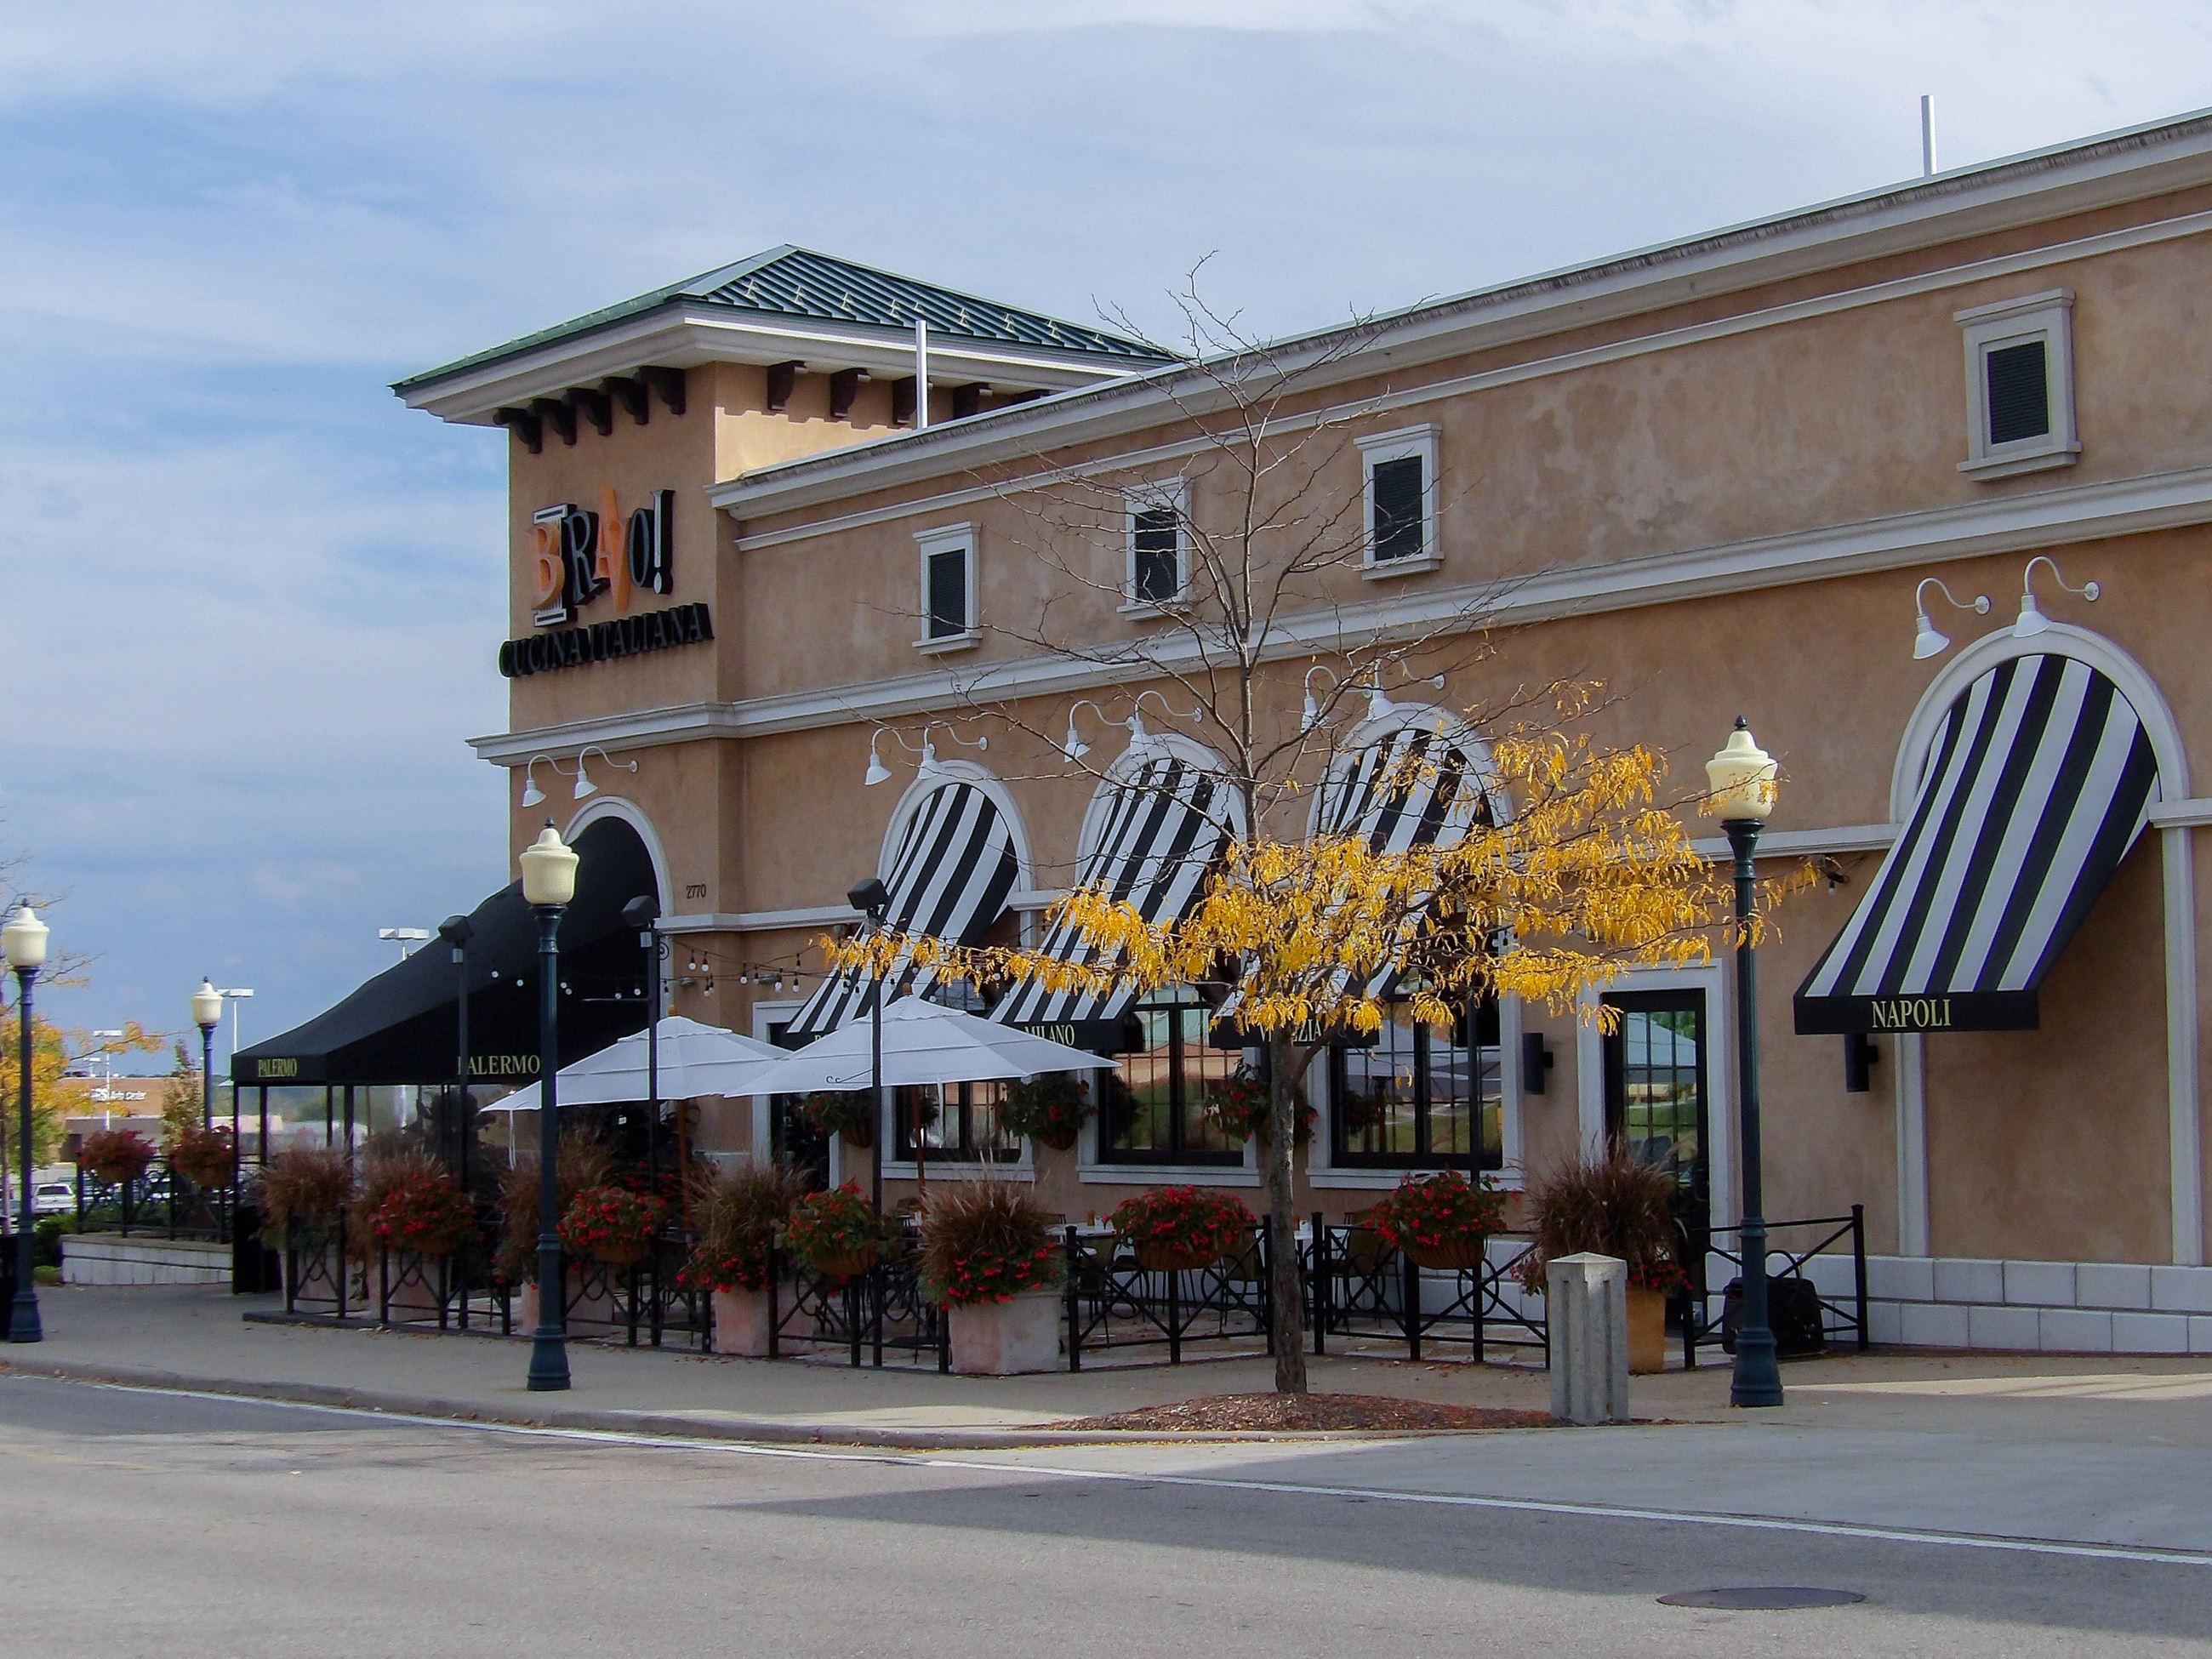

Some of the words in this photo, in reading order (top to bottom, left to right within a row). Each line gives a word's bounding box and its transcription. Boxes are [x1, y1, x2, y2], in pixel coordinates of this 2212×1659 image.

[588, 602, 714, 663] ITALIANA
[686, 884, 706, 898] 2770
[1872, 999, 1952, 1028] NAPOLI
[1259, 1018, 1321, 1042] VZIA
[258, 1058, 297, 1078] PALERMO
